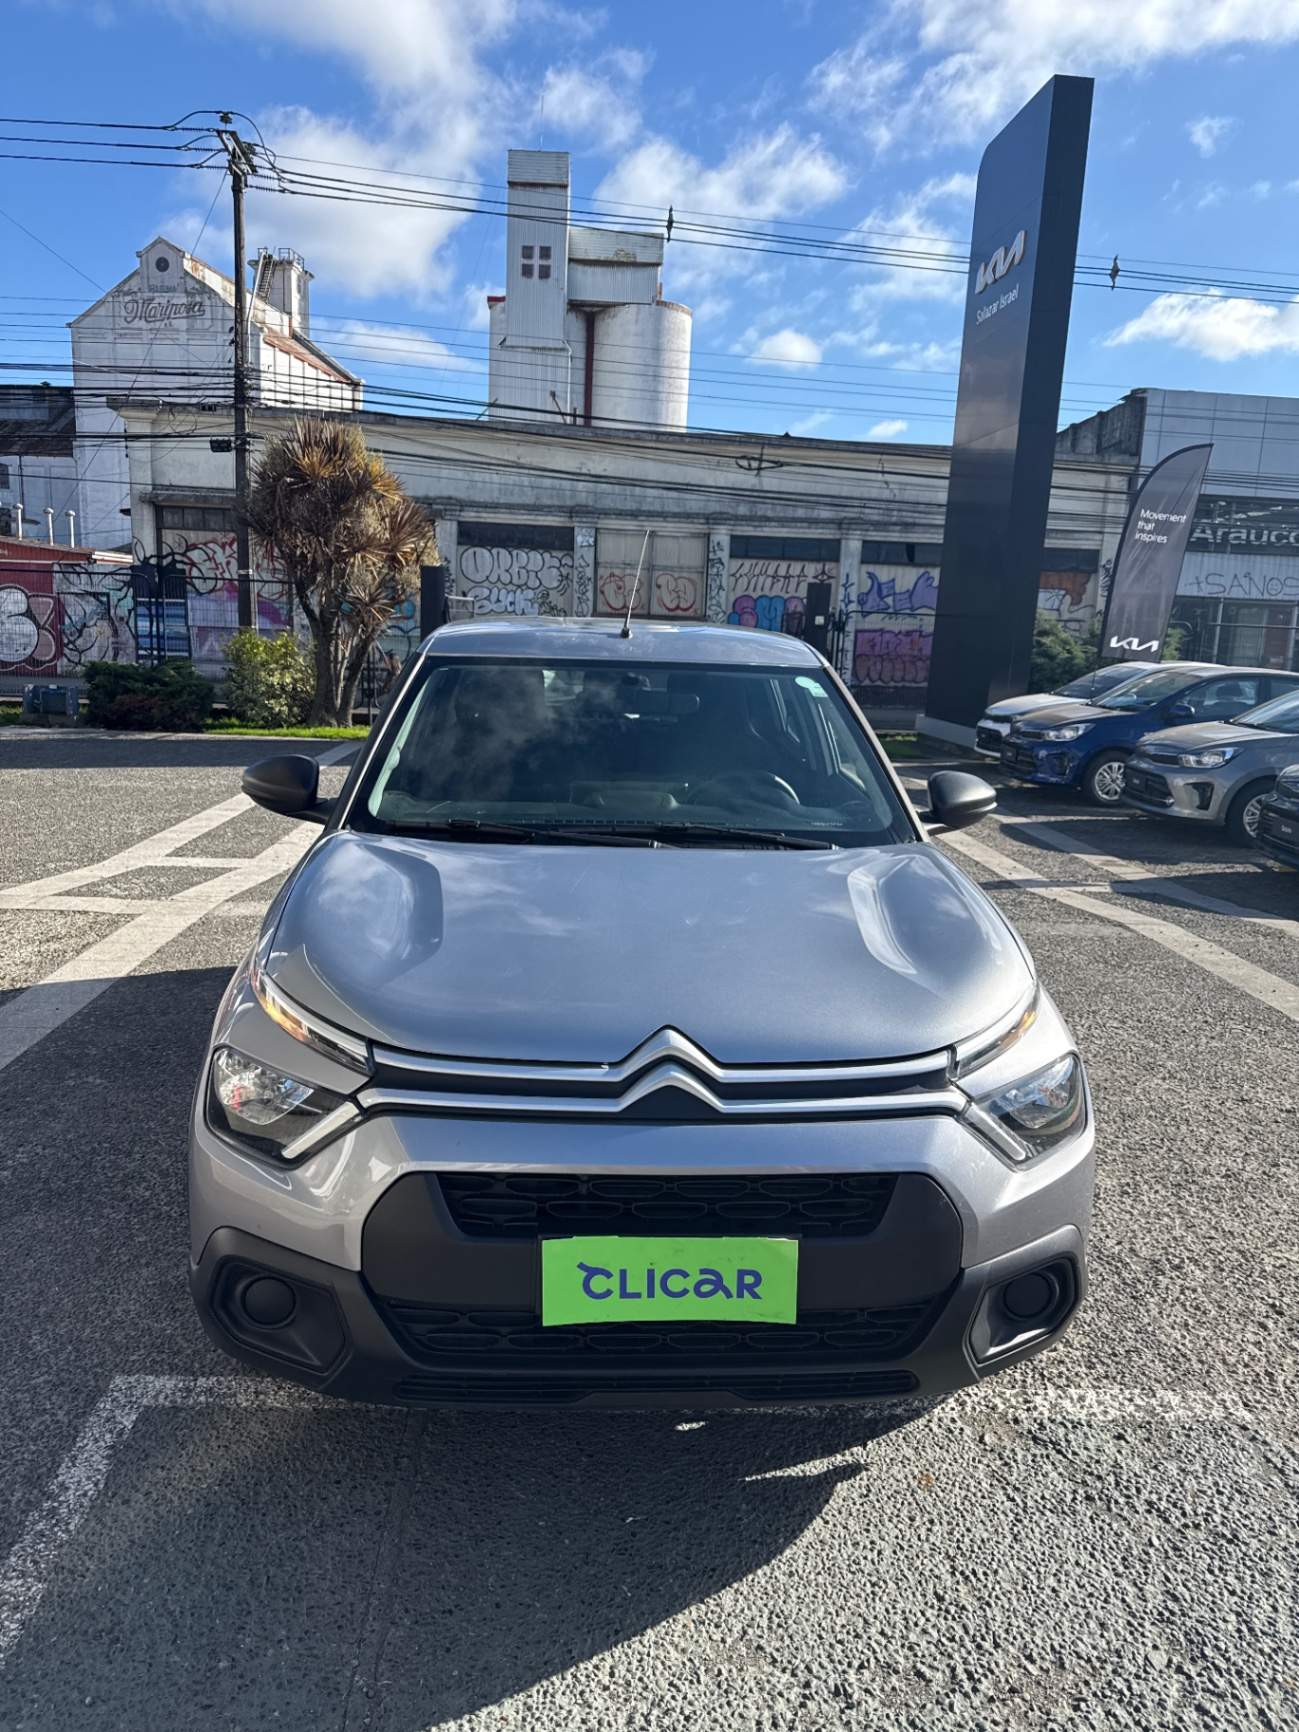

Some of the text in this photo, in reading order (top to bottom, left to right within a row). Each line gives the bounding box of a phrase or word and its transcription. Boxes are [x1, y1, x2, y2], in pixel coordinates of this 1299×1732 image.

[975, 230, 1025, 294] KIA
[1000, 283, 1019, 310] Israel
[1140, 508, 1187, 524] Movement
[1137, 520, 1155, 532] that
[1134, 531, 1169, 544] inspires
[1110, 635, 1160, 653] KIA
